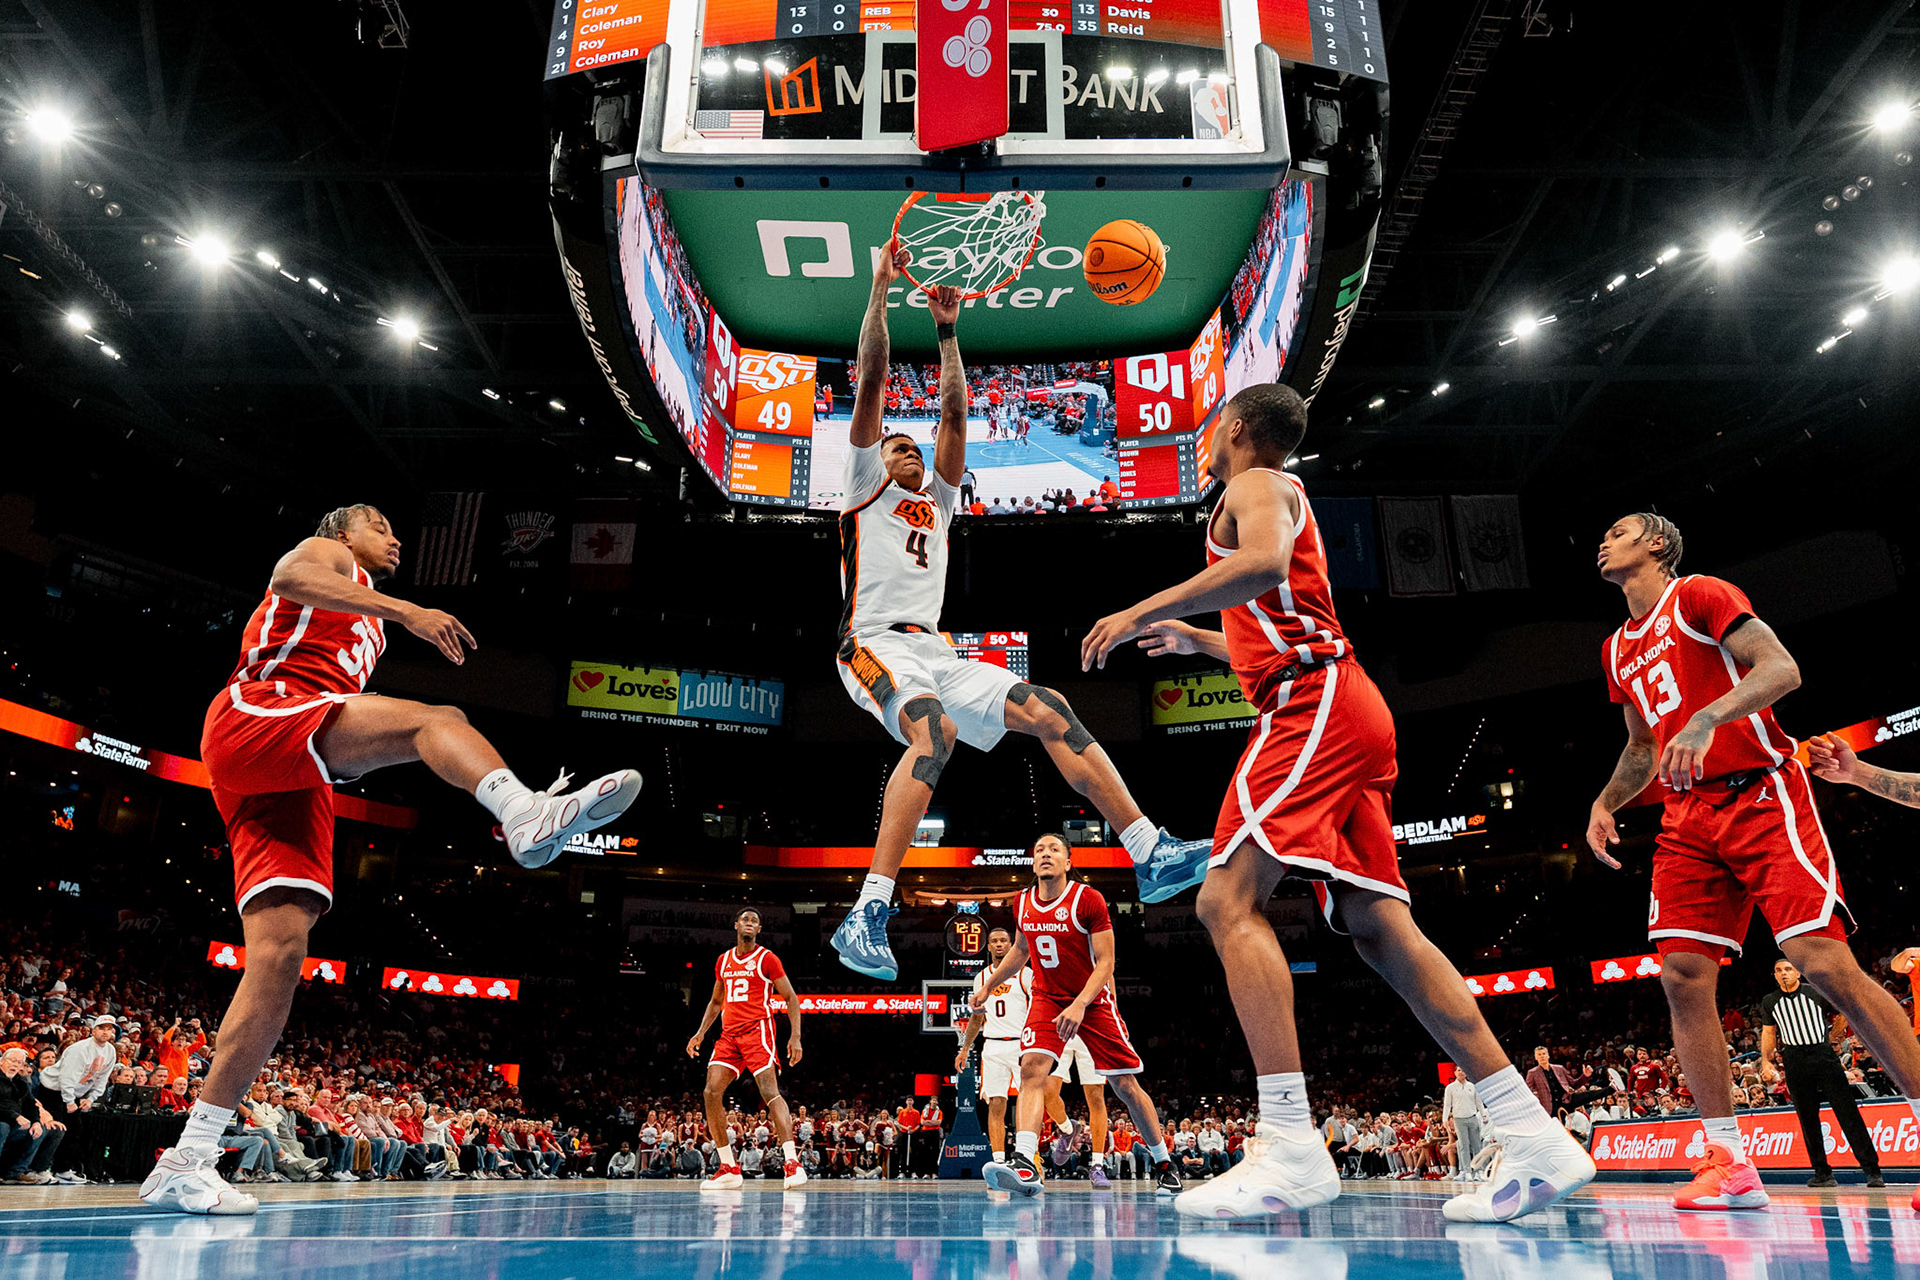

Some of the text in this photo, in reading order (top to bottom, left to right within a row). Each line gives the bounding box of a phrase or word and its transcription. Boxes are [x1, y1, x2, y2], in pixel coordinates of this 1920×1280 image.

[562, 4, 618, 25] 1 Clary
[790, 4, 845, 17] 13 0
[865, 7, 1059, 17] REB 30
[1078, 4, 1151, 20] 13 Davis
[1319, 6, 1366, 26] 15 1
[558, 14, 642, 41] 4 Coleman
[791, 21, 844, 34] 0 0
[1077, 20, 1144, 36] 35 Reid
[1325, 22, 1368, 41] 9 1
[556, 38, 606, 57] 9 Roy
[1327, 38, 1370, 57] 2 1
[551, 48, 639, 74] 21 Coleman
[1328, 54, 1374, 74] 5 0
[712, 368, 728, 411] 50
[1202, 371, 1217, 411] 49
[757, 400, 792, 431] 49
[1139, 401, 1172, 433] 50
[736, 432, 756, 440] PLAYER
[906, 530, 928, 569] 4
[990, 634, 1008, 645] 50
[1620, 635, 1676, 681] OKLAHOMA
[683, 682, 732, 711] LOUD
[739, 685, 779, 719] CITY
[1187, 687, 1249, 708] Love
[1631, 660, 1683, 728] 13
[581, 710, 768, 735] BRING THE THUNDER EXIT NOW
[1886, 706, 1920, 724] PRESENT
[1167, 719, 1257, 735] BRING THE THUN
[92, 732, 142, 754] PRESENTED BY
[1392, 816, 1466, 840] BEDLAM
[566, 833, 620, 850] DLAM
[1408, 833, 1453, 845] BASKETBALL
[956, 922, 981, 934] 12:15
[1023, 923, 1069, 932] OKLAHOMA
[961, 934, 979, 953] 19
[1035, 935, 1060, 968] 9
[723, 970, 755, 978] OKLAHOMA
[726, 978, 749, 1003] 12
[995, 1000, 1006, 1018] 0
